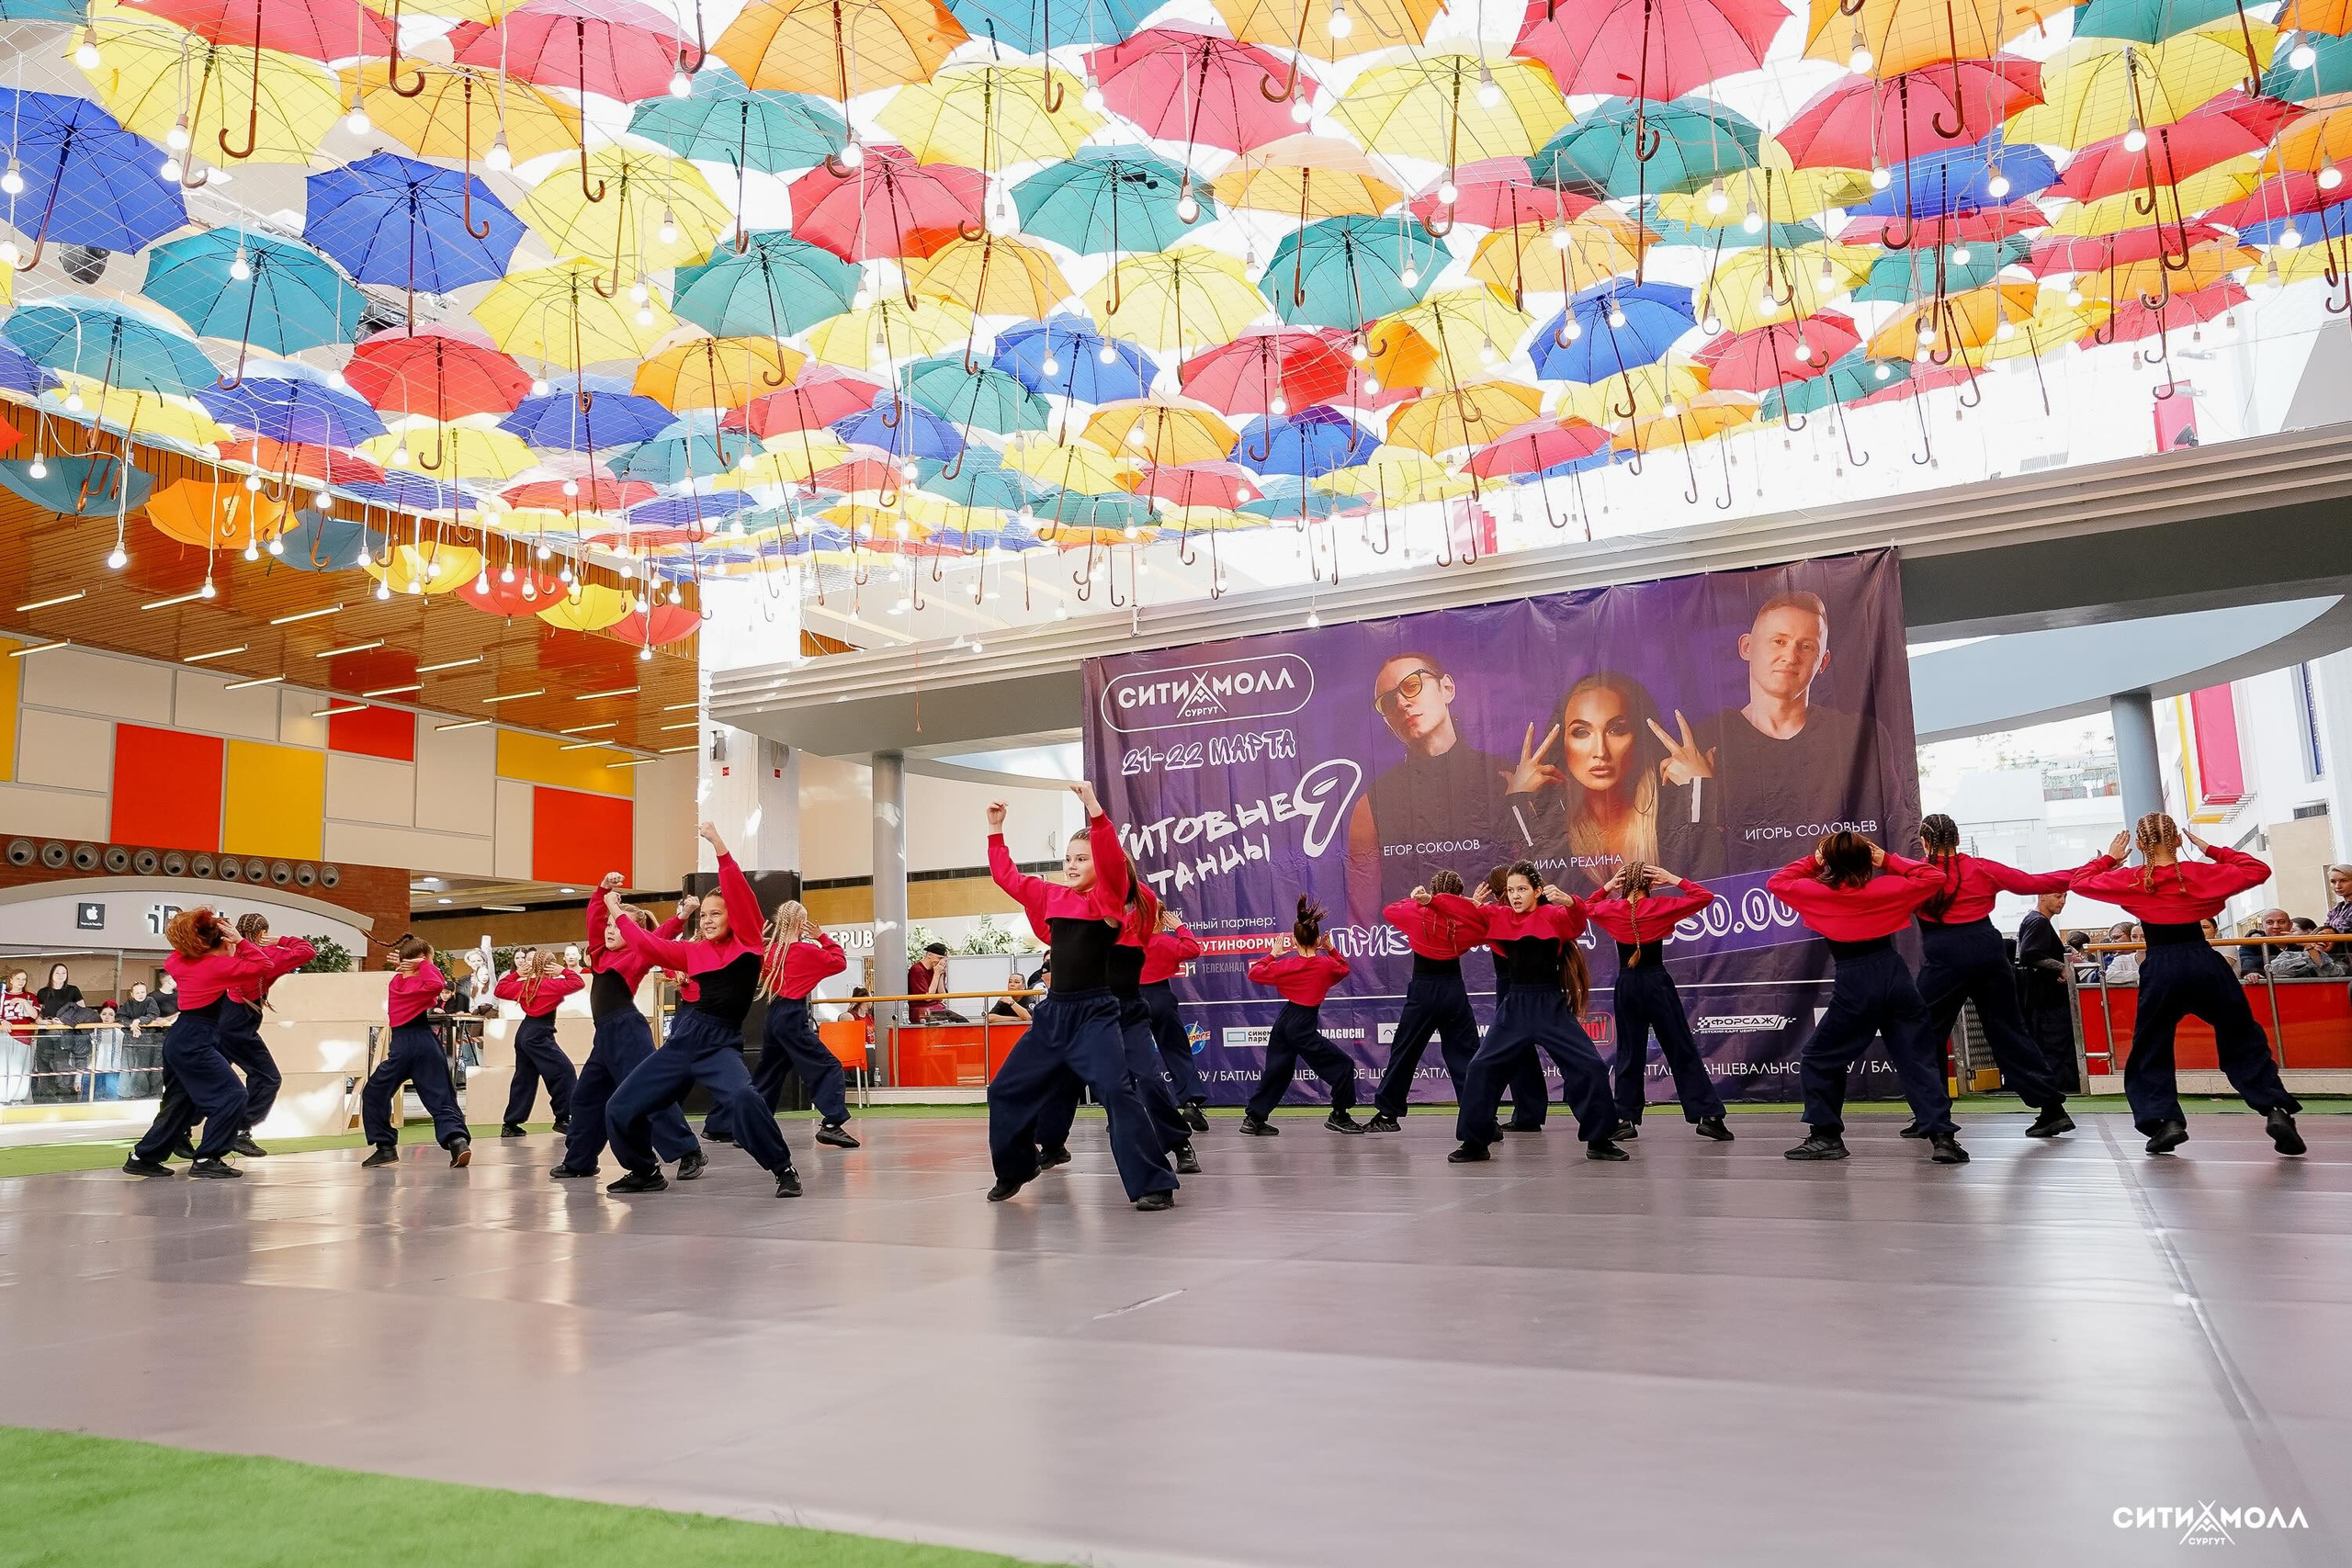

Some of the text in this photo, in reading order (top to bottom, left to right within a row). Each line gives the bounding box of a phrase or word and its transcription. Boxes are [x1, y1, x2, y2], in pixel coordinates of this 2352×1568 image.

[1184, 705, 1219, 717] СУРГУТ
[1121, 728, 1296, 775] 21-22 МАРТА
[1745, 820, 1878, 840] ИГОРЬ СОЛОВЬЕВ
[1384, 839, 1480, 857] ЕГОР СОКОЛОВ
[1146, 833, 1271, 896] ТАНЦЫ
[1570, 854, 1623, 868] РЕДИНА
[1221, 916, 1276, 929] партнер:
[1329, 924, 1413, 957] ПРИЗ
[1202, 962, 1246, 974] ТЕЛЕКАНАЛ
[1711, 1017, 1775, 1026] ФОРСАЖ
[1220, 1070, 1261, 1081] БАТТЛЫ
[1413, 1067, 1452, 1079] БАТТЛ
